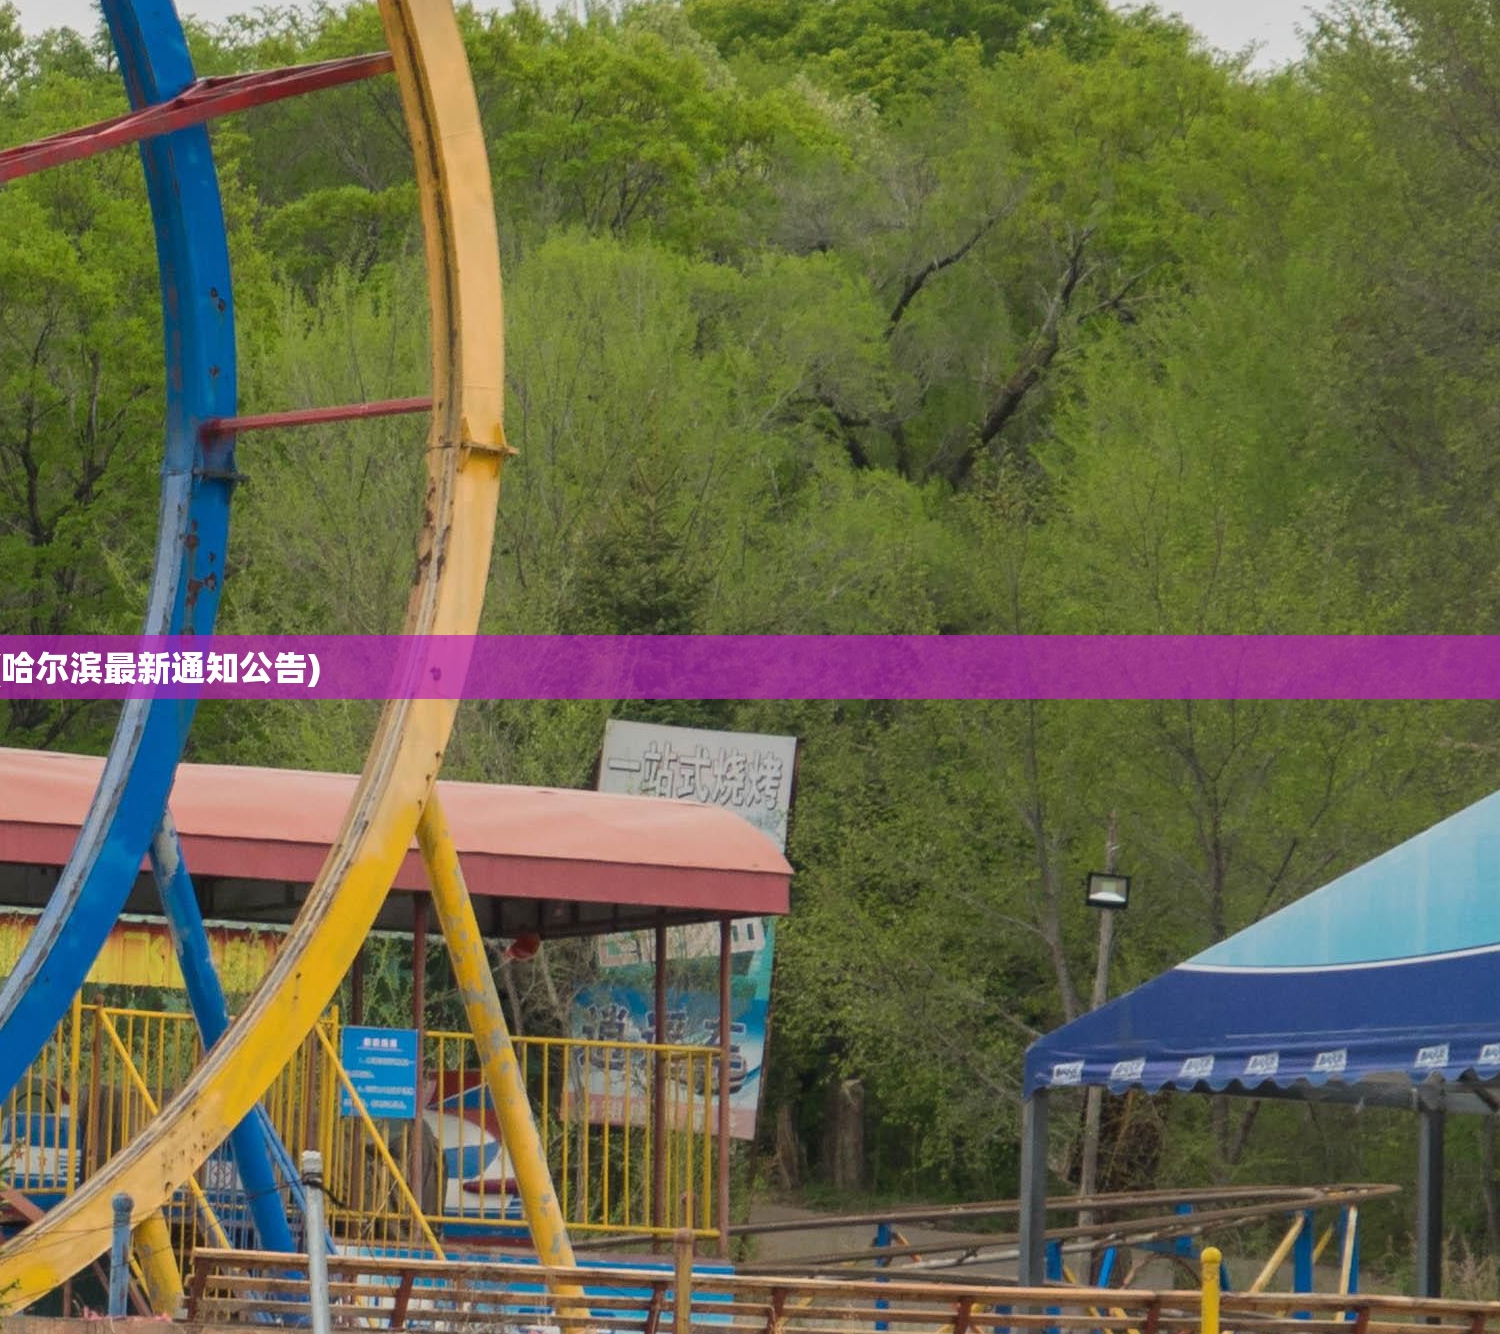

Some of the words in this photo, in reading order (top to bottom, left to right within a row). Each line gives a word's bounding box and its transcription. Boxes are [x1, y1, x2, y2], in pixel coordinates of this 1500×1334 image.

[607, 739, 784, 810] 一站式烧烤
